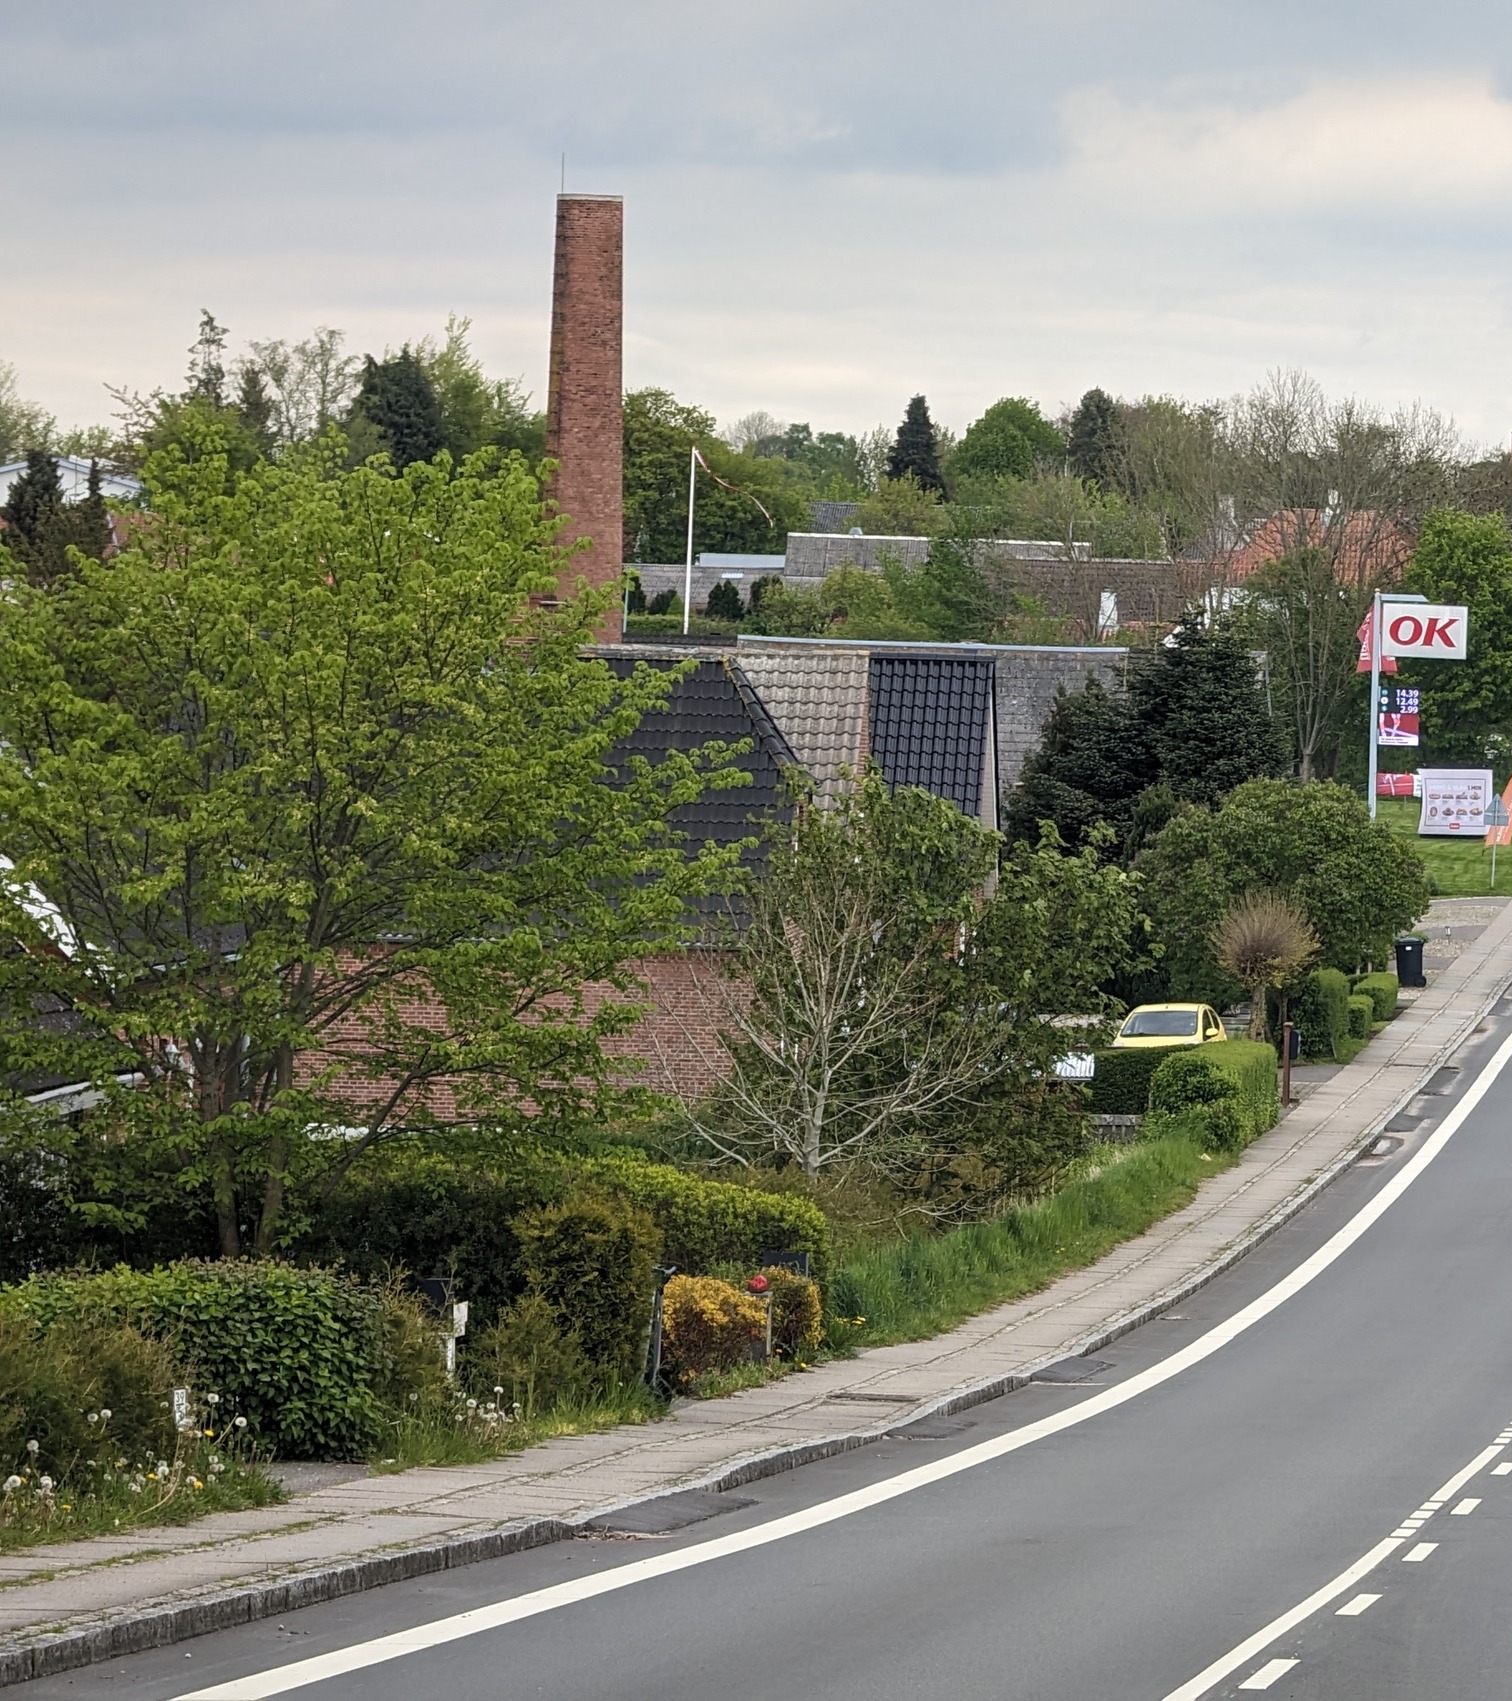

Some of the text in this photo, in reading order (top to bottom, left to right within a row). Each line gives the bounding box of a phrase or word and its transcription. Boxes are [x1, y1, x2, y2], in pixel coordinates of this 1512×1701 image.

[1389, 615, 1460, 648] OK
[1396, 689, 1419, 698] 14.39
[1396, 697, 1419, 706] 12.49
[1400, 705, 1419, 714] 2.99
[175, 1392, 184, 1403] 39
